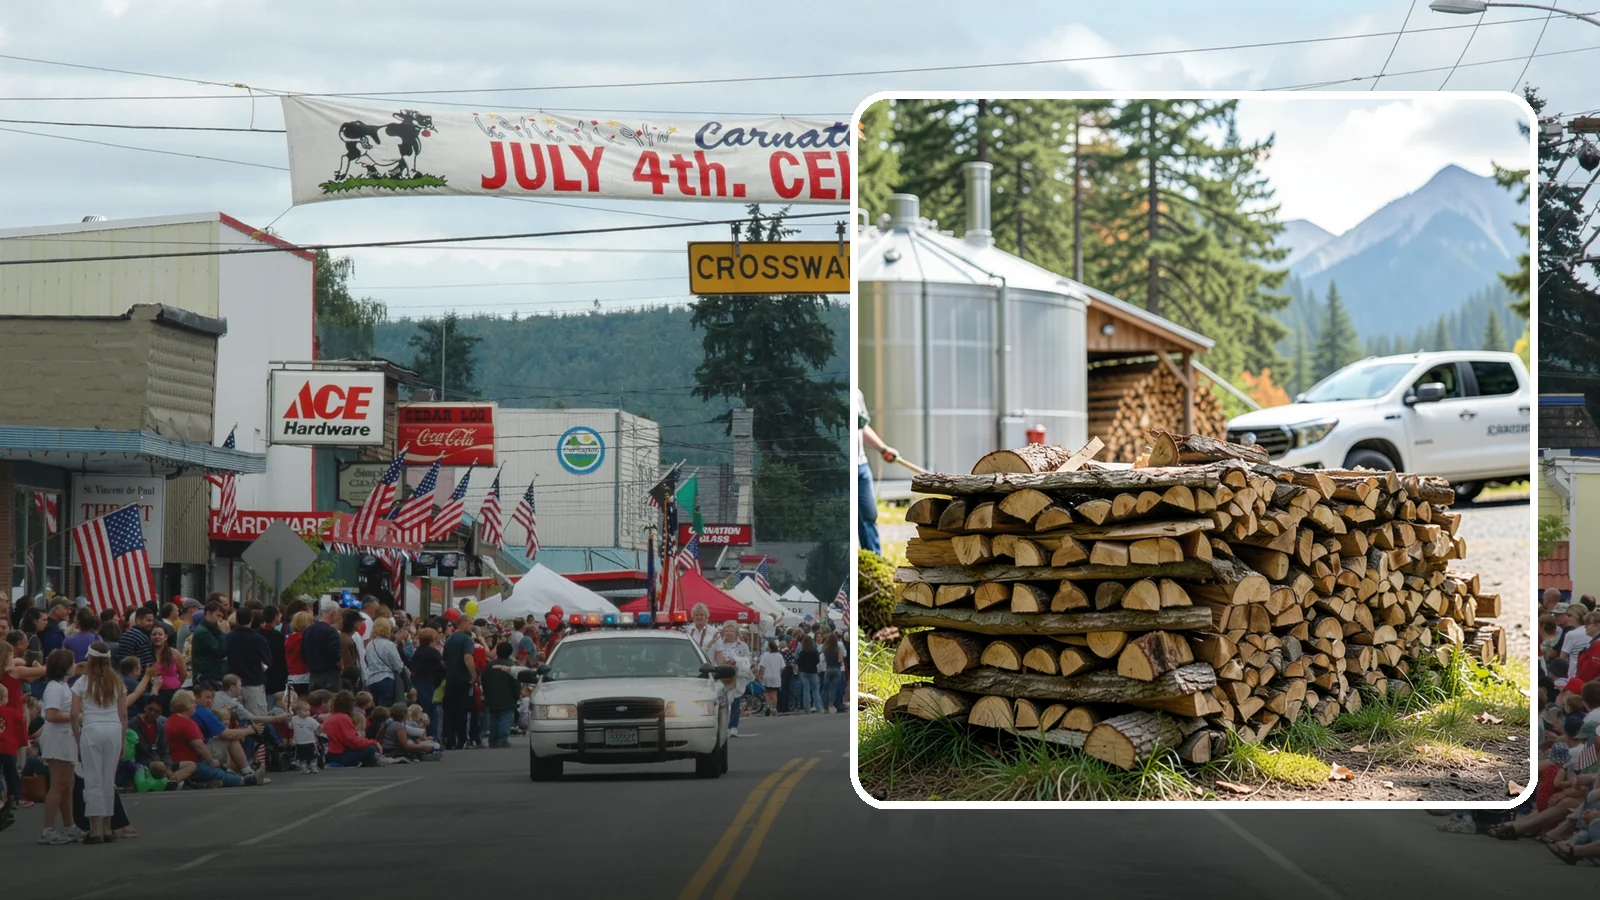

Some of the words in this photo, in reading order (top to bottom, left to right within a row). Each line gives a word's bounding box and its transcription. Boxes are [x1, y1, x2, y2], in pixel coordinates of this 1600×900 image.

[695, 121, 850, 150] Carnat
[481, 141, 605, 192] JULY
[632, 149, 746, 197] 4th.
[697, 254, 850, 280] CROSSWA
[283, 380, 373, 420] ACE
[405, 409, 453, 422] CEDAR
[461, 409, 485, 421] LOG
[283, 421, 371, 436] Hardware
[416, 428, 477, 447] Coca-Cola
[83, 485, 94, 494] St.
[95, 485, 124, 494] Vincent
[126, 486, 135, 495] de
[137, 486, 155, 495] Paul
[699, 535, 730, 543] GLASS
